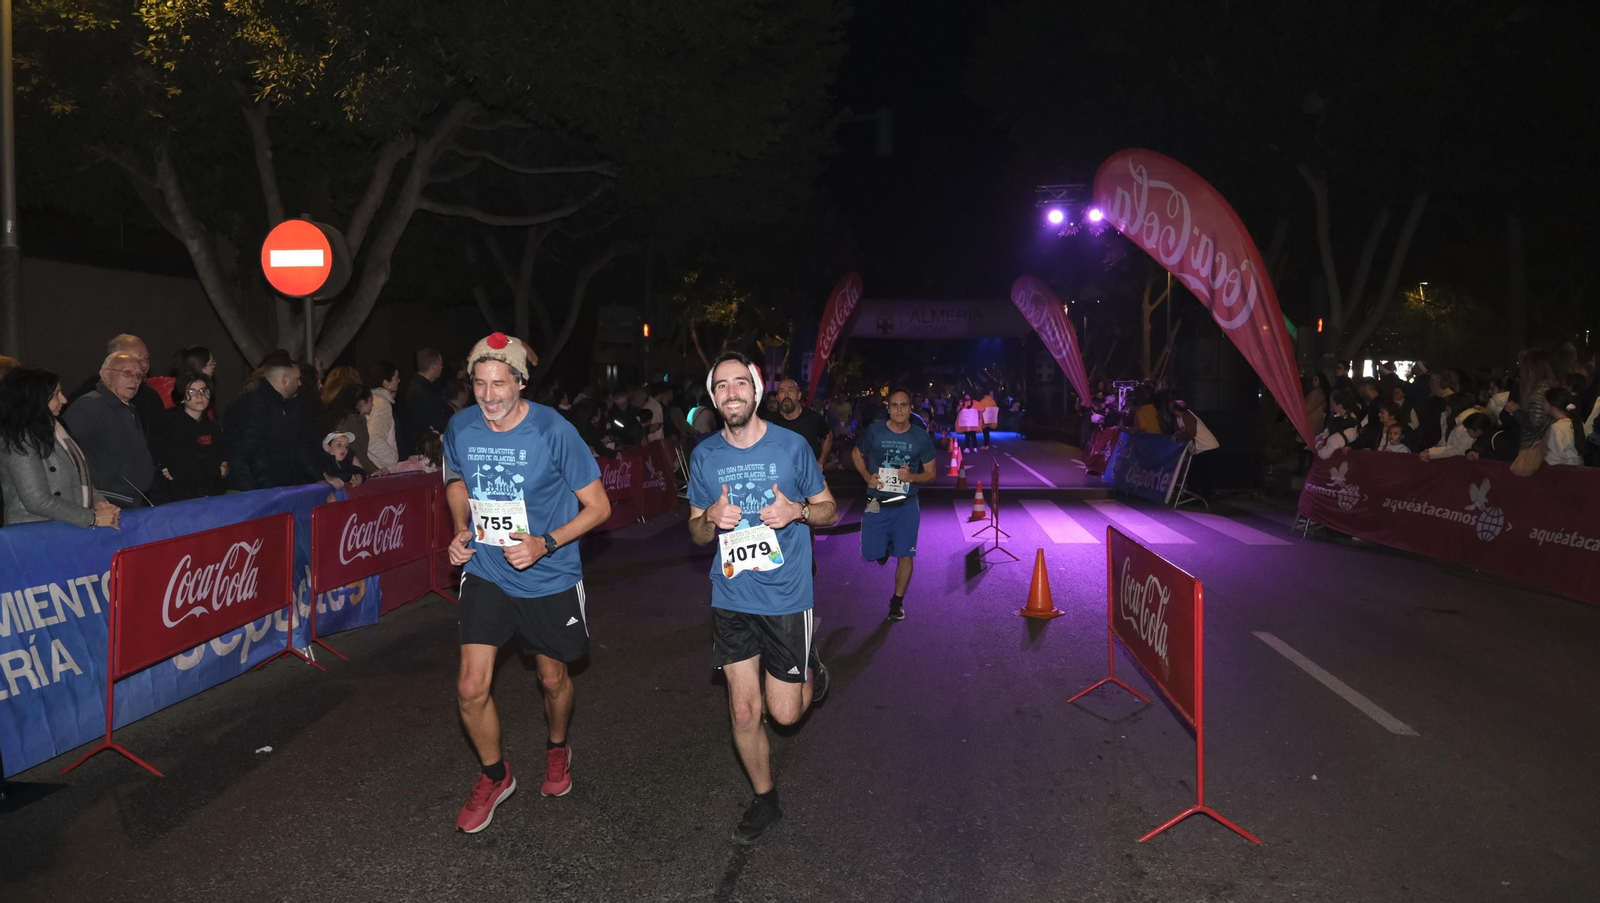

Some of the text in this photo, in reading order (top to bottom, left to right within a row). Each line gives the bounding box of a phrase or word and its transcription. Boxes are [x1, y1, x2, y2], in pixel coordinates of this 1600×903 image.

[339, 502, 406, 565] Coca-Cola
[481, 516, 513, 530] 755
[1382, 497, 1478, 527] aquéatacamos
[728, 541, 771, 563] 1079
[162, 537, 264, 628] Coca-Cola
[1120, 556, 1171, 661] Coca-Cola
